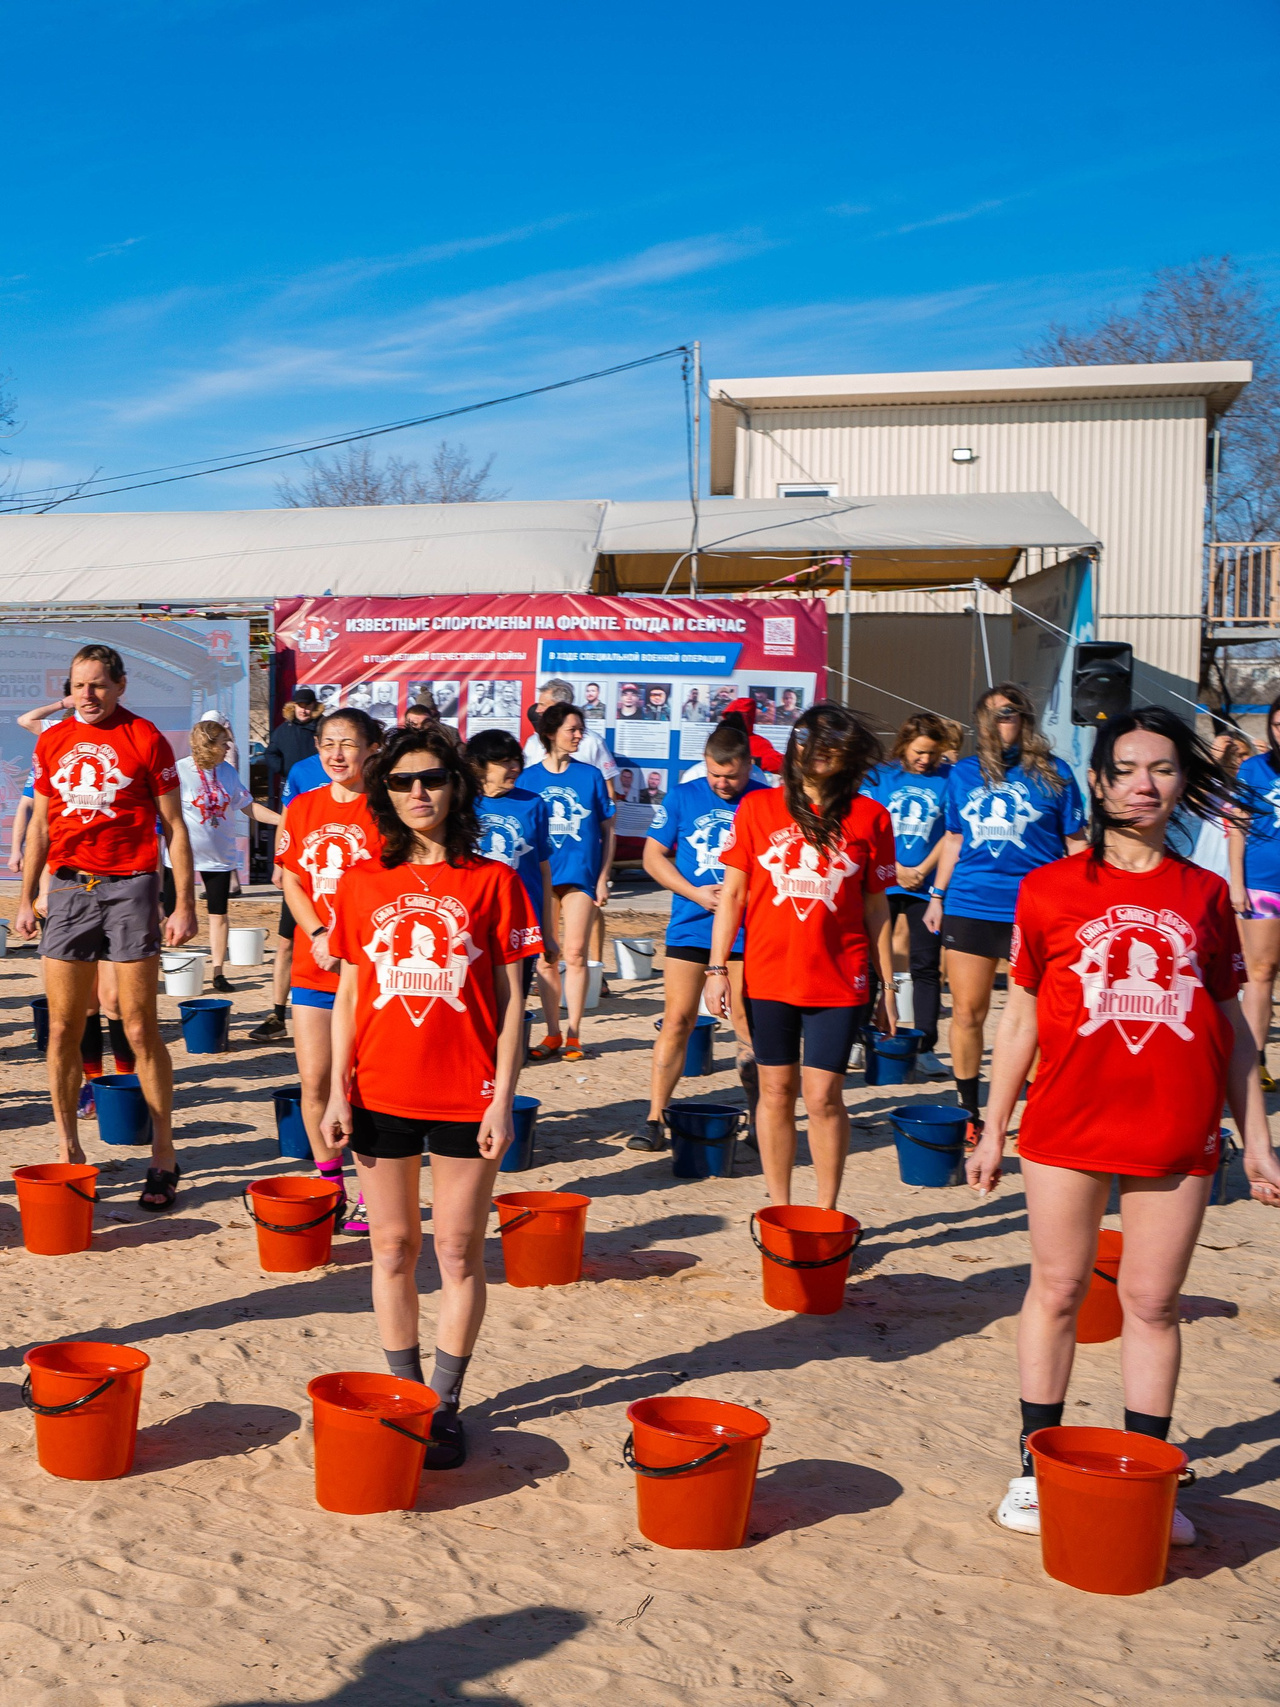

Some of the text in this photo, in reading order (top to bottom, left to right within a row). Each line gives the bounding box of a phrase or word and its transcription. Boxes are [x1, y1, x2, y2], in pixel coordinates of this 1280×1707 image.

[345, 617, 430, 632] ИЗВЕСТНЫЕ
[432, 616, 532, 631] СПОРТСМЕНЫ
[534, 616, 556, 630] НА
[557, 615, 621, 631] ФРОНТЕ.
[623, 617, 670, 634] ТОГДА
[673, 617, 685, 631] И
[686, 615, 747, 632] СЕЙЧАС
[548, 651, 726, 664] В ХОДЕ СПЕЦИАЛЬНОЙ ВОЕННОЙ ОПЕРАЦИИ
[134, 671, 174, 693] АКЦИЯ
[385, 967, 453, 992] ЯРОПОЛК
[1096, 990, 1180, 1017] ЯРОПОЛК
